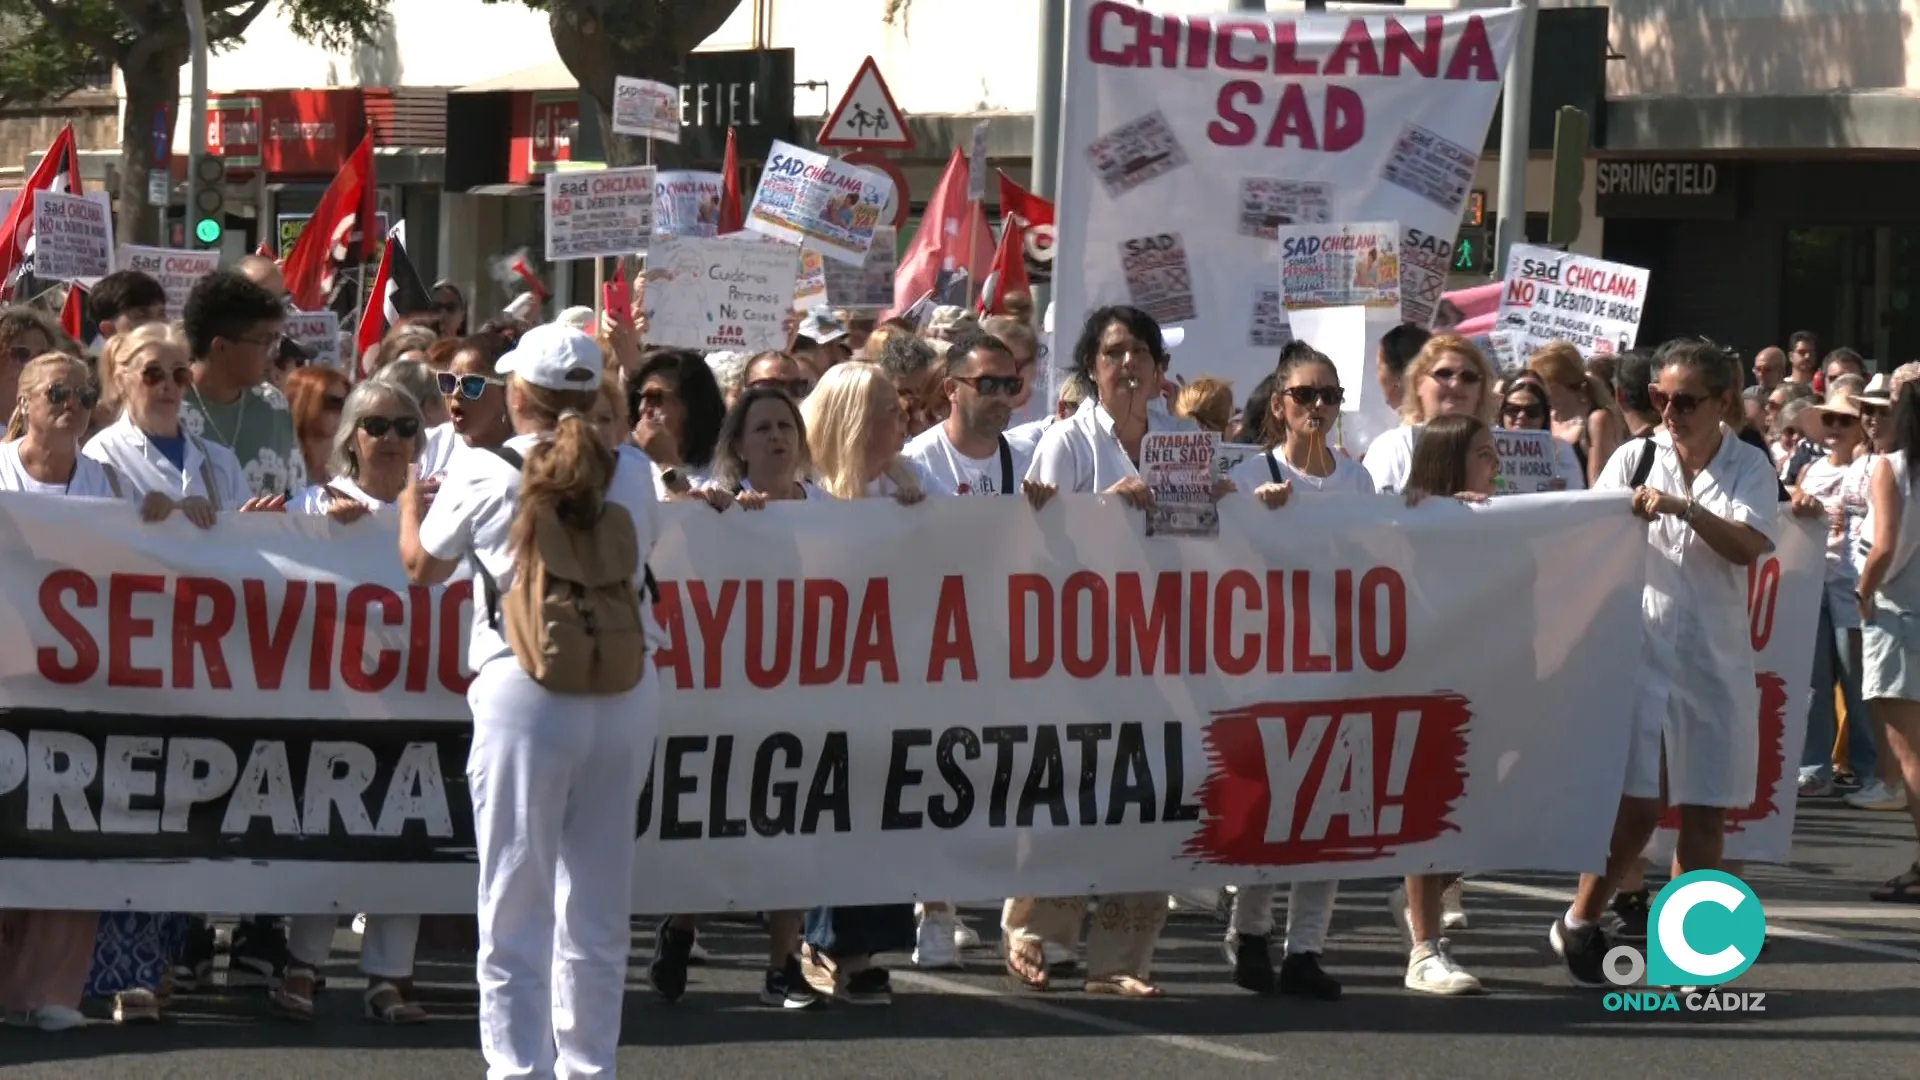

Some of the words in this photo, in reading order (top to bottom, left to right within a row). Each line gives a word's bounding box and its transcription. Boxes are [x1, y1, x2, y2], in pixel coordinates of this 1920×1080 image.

[1088, 2, 1499, 82] CHICLANA
[1208, 80, 1365, 151] SAD
[560, 179, 589, 195] sad
[592, 176, 647, 194] CHICLANA
[768, 155, 804, 176] SAD
[802, 165, 863, 193] CHICLANA
[1597, 163, 1716, 195] SPRINGFIELD
[552, 197, 572, 215] NO
[1125, 234, 1175, 254] SAD
[1282, 236, 1321, 258] SAD
[1321, 234, 1377, 254] CHICLANA
[1405, 228, 1451, 258] SAD
[1522, 258, 1562, 281] sad
[1566, 265, 1637, 299] CHICLANA
[719, 303, 738, 320] No
[1507, 280, 1535, 302] NO
[1538, 288, 1550, 304] AL
[1553, 287, 1594, 314] DÉBITO
[1593, 299, 1606, 317] DE
[1606, 301, 1640, 324] HORAS
[718, 324, 744, 336] SAD
[1529, 310, 1551, 323] QUE
[1554, 316, 1591, 333] PAGUEN
[1592, 325, 1604, 336] EL
[1146, 433, 1212, 449] ¿TRABAJAS
[1145, 448, 1160, 463] EN
[1162, 448, 1176, 462] EL
[1179, 446, 1216, 464] SAD?
[1520, 461, 1553, 477] HORAS
[37, 568, 476, 694] SERVICIO
[652, 576, 899, 690] AYUDA
[926, 575, 979, 683] A
[1009, 566, 1408, 680] DOMICILIO
[881, 721, 1201, 830] ESTATAL
[1256, 709, 1423, 844] YA!
